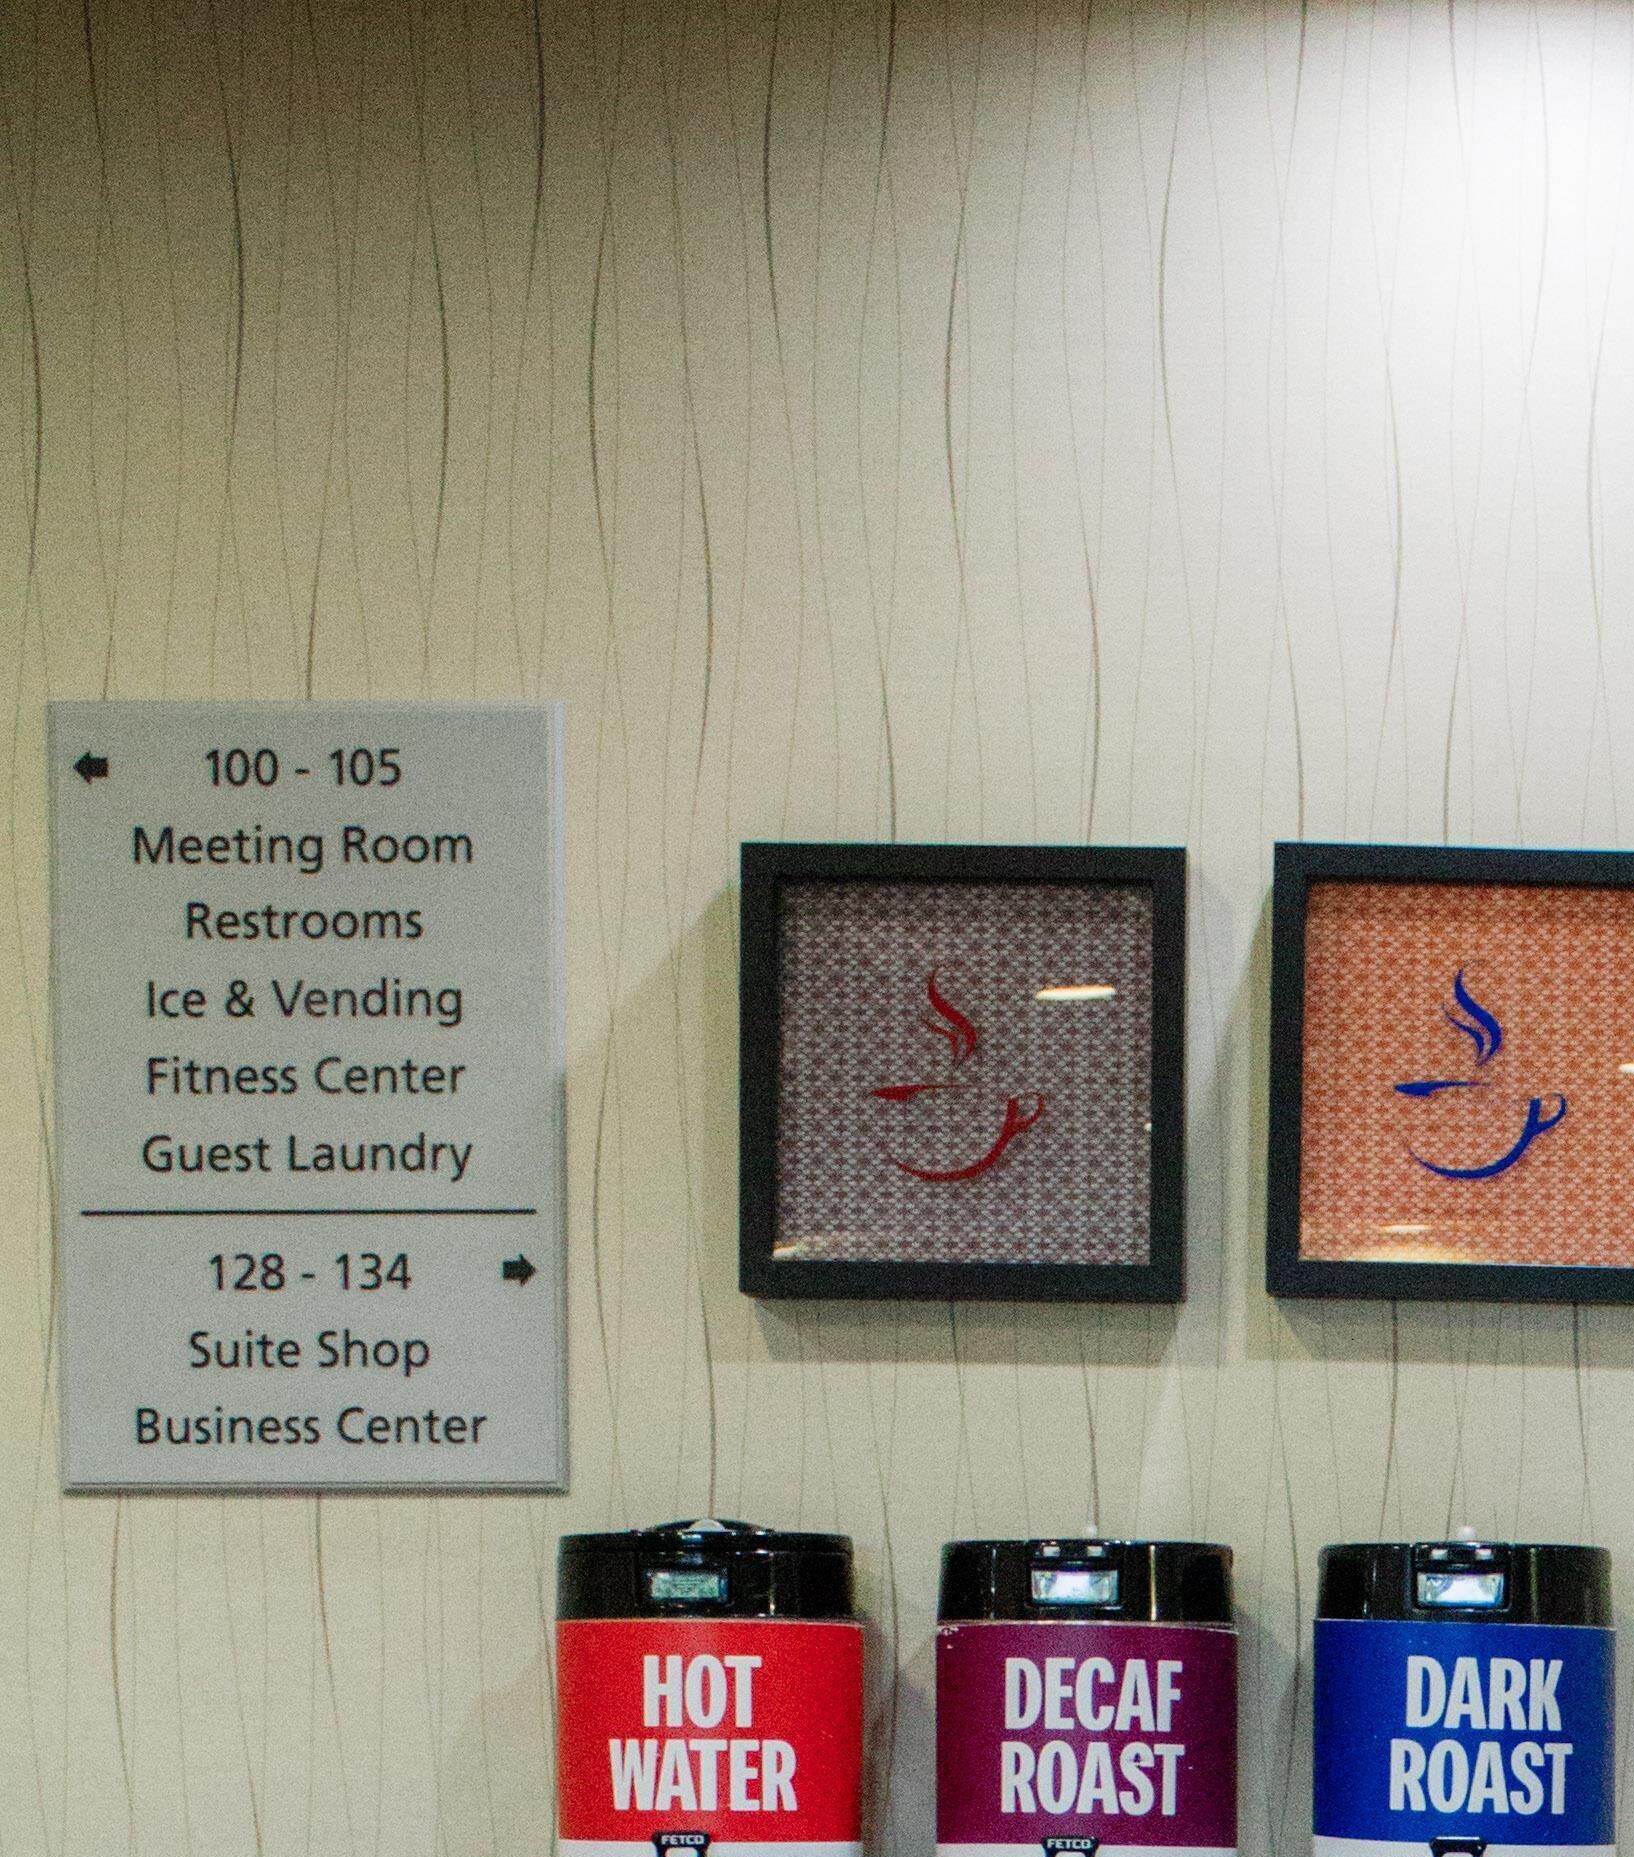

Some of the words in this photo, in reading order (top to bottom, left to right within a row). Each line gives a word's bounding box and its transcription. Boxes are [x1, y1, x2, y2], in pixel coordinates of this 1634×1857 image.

[206, 749, 278, 786] 100
[330, 748, 401, 786] 105
[134, 825, 323, 874] Meeting
[343, 826, 472, 863] Room
[187, 902, 422, 939] Restrooms
[148, 982, 206, 1018] Ice
[226, 980, 253, 1017] &
[272, 978, 461, 1027] Vending
[148, 1056, 297, 1094] Fitness
[315, 1057, 465, 1094] Center
[143, 1135, 270, 1172] Guest
[289, 1133, 472, 1182] Laundry
[211, 1254, 285, 1290] 128
[336, 1253, 411, 1290] 134
[190, 1330, 300, 1368] Suite
[318, 1329, 429, 1377] Shop
[137, 1407, 320, 1444] Business
[337, 1407, 486, 1444] Center
[644, 1654, 762, 1728] HOT
[1005, 1657, 1182, 1732] DECAF
[1406, 1656, 1562, 1730] DARK
[609, 1738, 797, 1811] WATER
[1001, 1740, 1184, 1815] ROAST
[1390, 1739, 1572, 1815] ROAST
[661, 1835, 704, 1845] FETCO
[1047, 1839, 1092, 1849] FETCO
